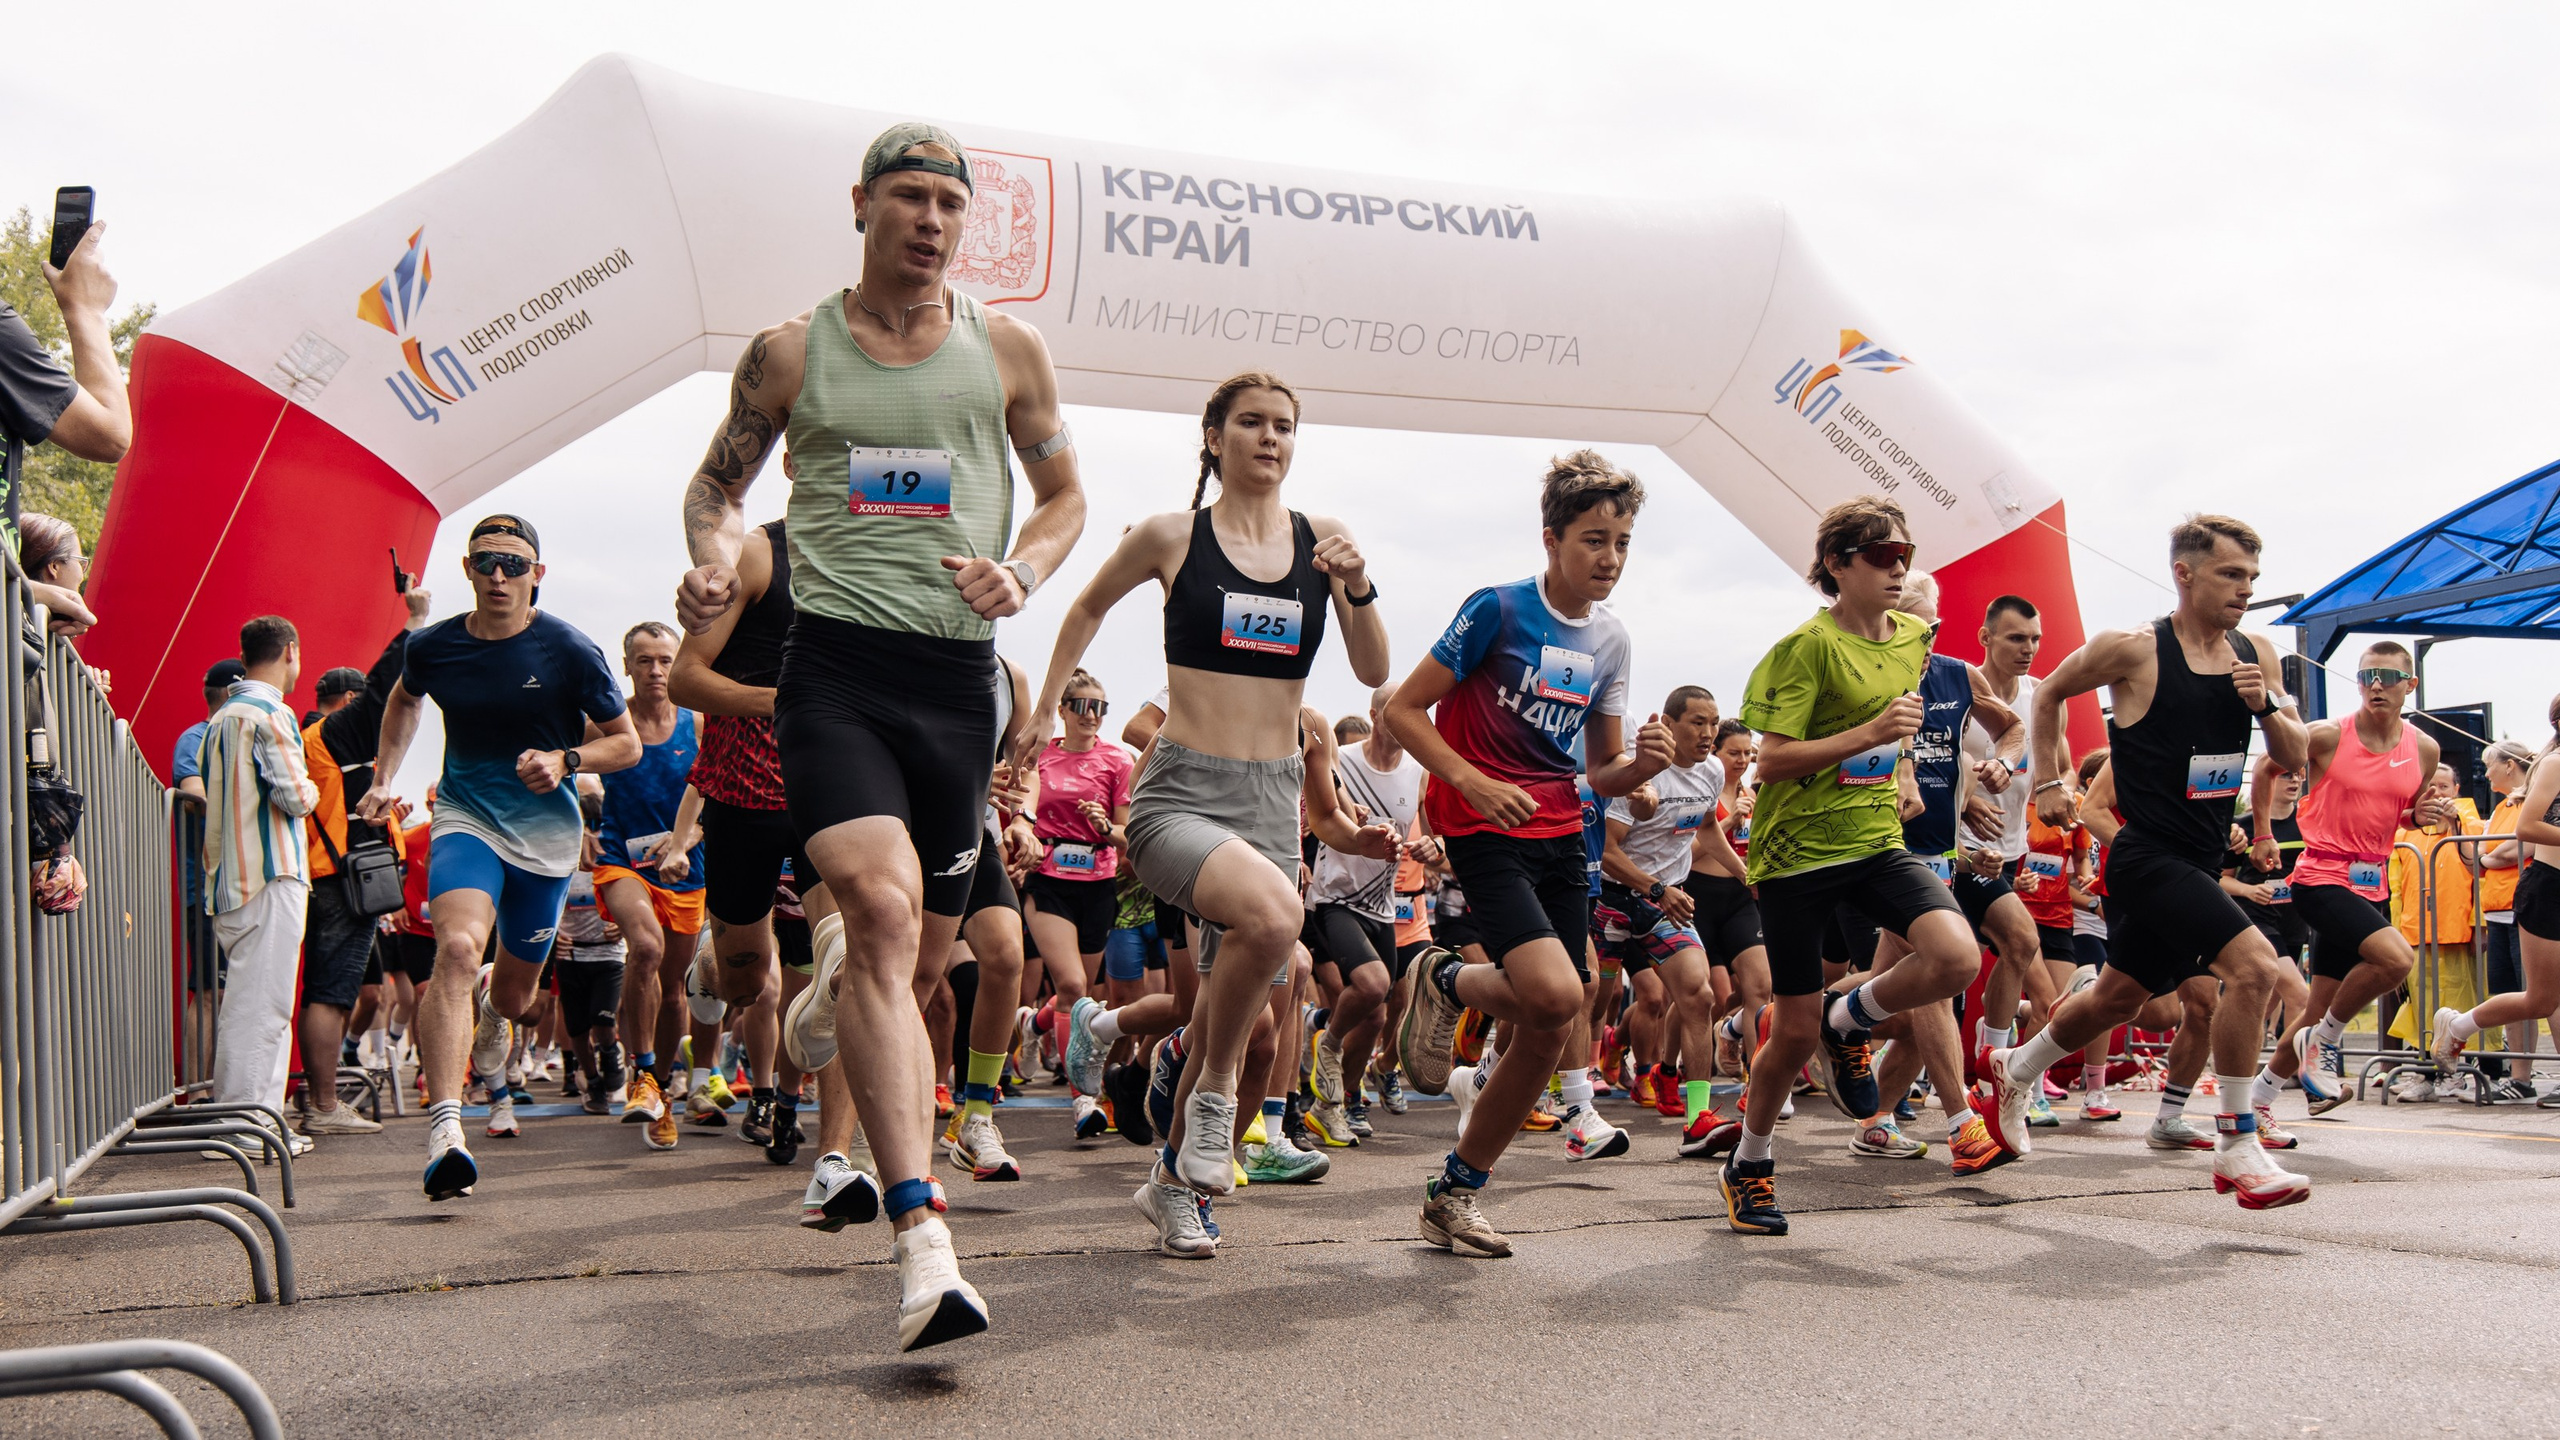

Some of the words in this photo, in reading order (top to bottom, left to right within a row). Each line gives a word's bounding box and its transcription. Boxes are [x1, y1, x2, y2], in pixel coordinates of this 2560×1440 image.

[1102, 165, 1539, 241] КРАСНОЯРСКИЙ
[1104, 210, 1250, 268] КРАЙ
[460, 312, 516, 355] ЦЕНТР
[519, 247, 635, 323] СПОРТИВНОЙ
[1096, 295, 1425, 355] МИНИСТЕРСТВО
[1437, 327, 1580, 366] СПОРТА
[480, 308, 594, 382] ПОДГОТОВКИ
[1821, 421, 1900, 494] ПОДГОТОВКИ
[1840, 402, 1882, 440] ЦЕНТР
[1878, 437, 1958, 511] СПОРТИВНОЙ
[882, 470, 921, 495] 19
[858, 503, 895, 514] XXXVII
[1241, 612, 1287, 637] 125
[1228, 638, 1257, 649] XXXVII
[1562, 667, 1573, 685] 3
[1543, 688, 1564, 699] XXXVII
[1497, 685, 1584, 737] НАЦИ
[1815, 714, 1845, 727] МОСКВА
[1858, 695, 1882, 711] ГОРОД
[1914, 726, 1952, 744] NTEN
[1868, 755, 1880, 771] 9
[1842, 776, 1867, 784] XXXVII
[2208, 769, 2229, 786] 16
[1684, 815, 1697, 826] 34
[1062, 853, 1087, 865] 138
[2031, 861, 2056, 873] 127
[2362, 871, 2374, 882] 12
